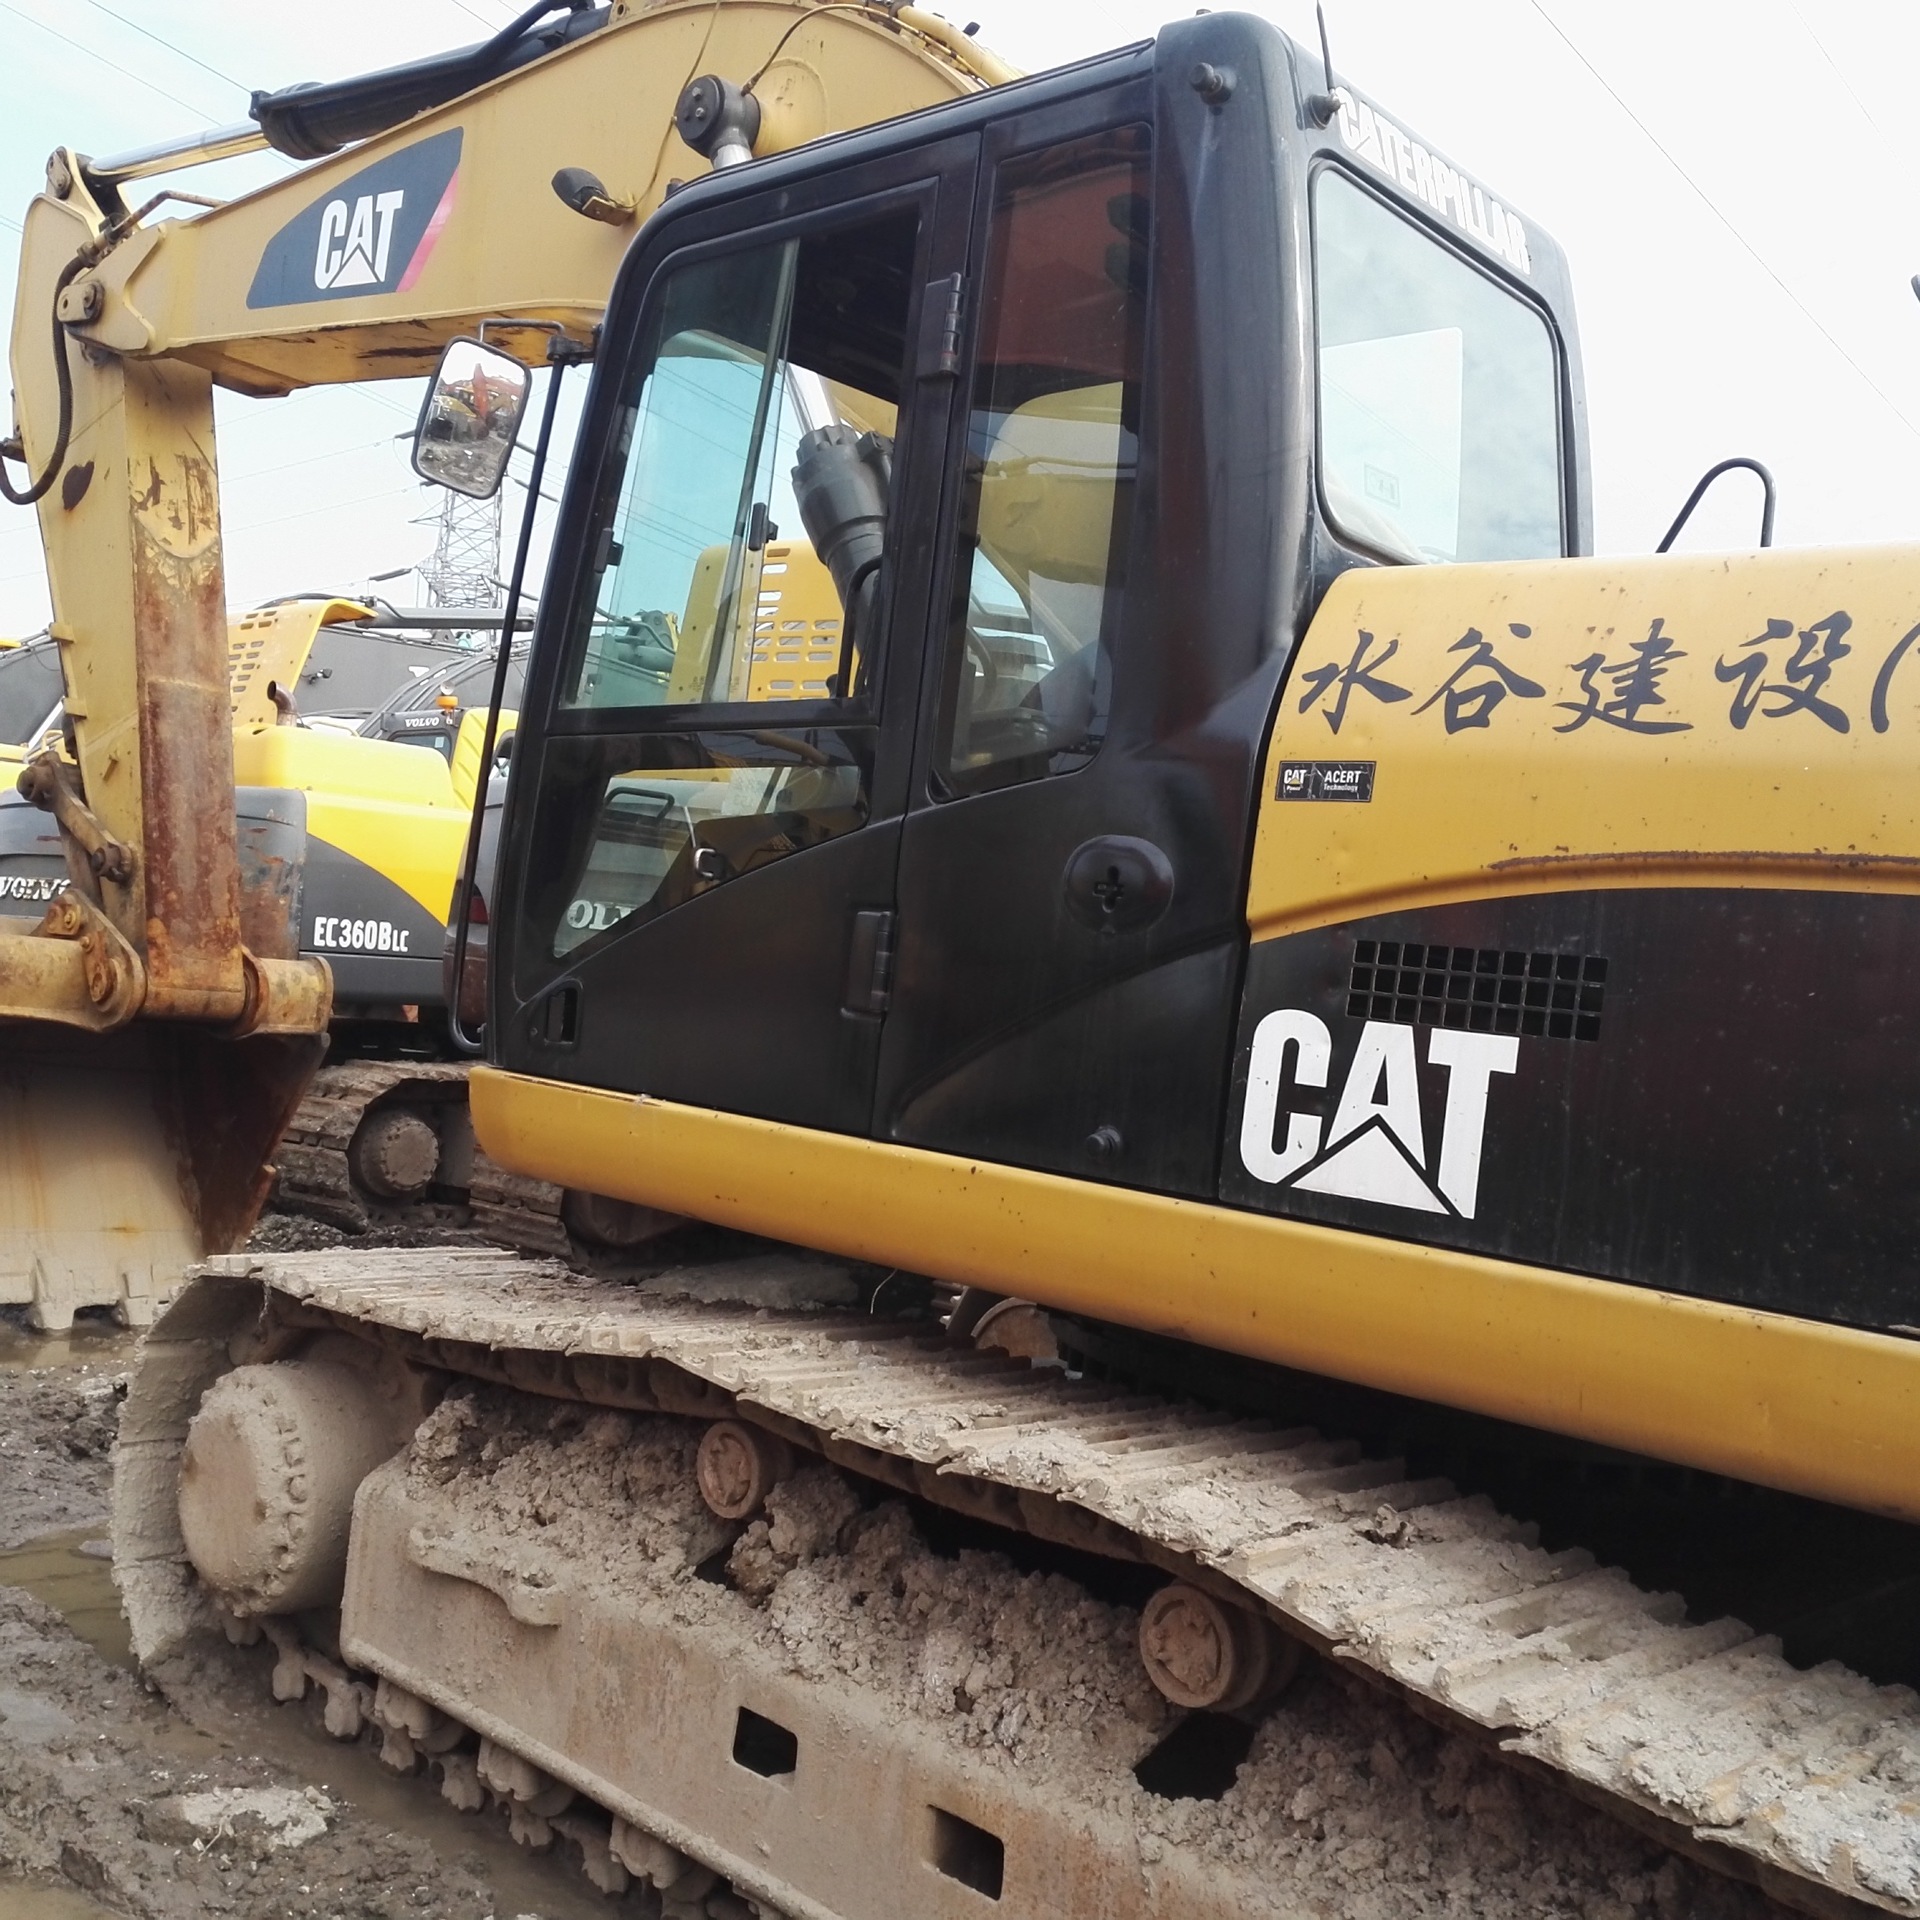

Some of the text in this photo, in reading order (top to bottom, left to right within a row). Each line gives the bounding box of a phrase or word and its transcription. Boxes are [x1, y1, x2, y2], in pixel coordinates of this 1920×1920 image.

[1335, 86, 1531, 275] CATERPILLAR
[315, 189, 404, 289] CAT
[405, 717, 440, 727] VOLVO
[1284, 769, 1307, 784] CAT
[1324, 770, 1361, 783] ACERT
[1324, 783, 1358, 792] Technology
[1240, 1008, 1520, 1219] CAT
